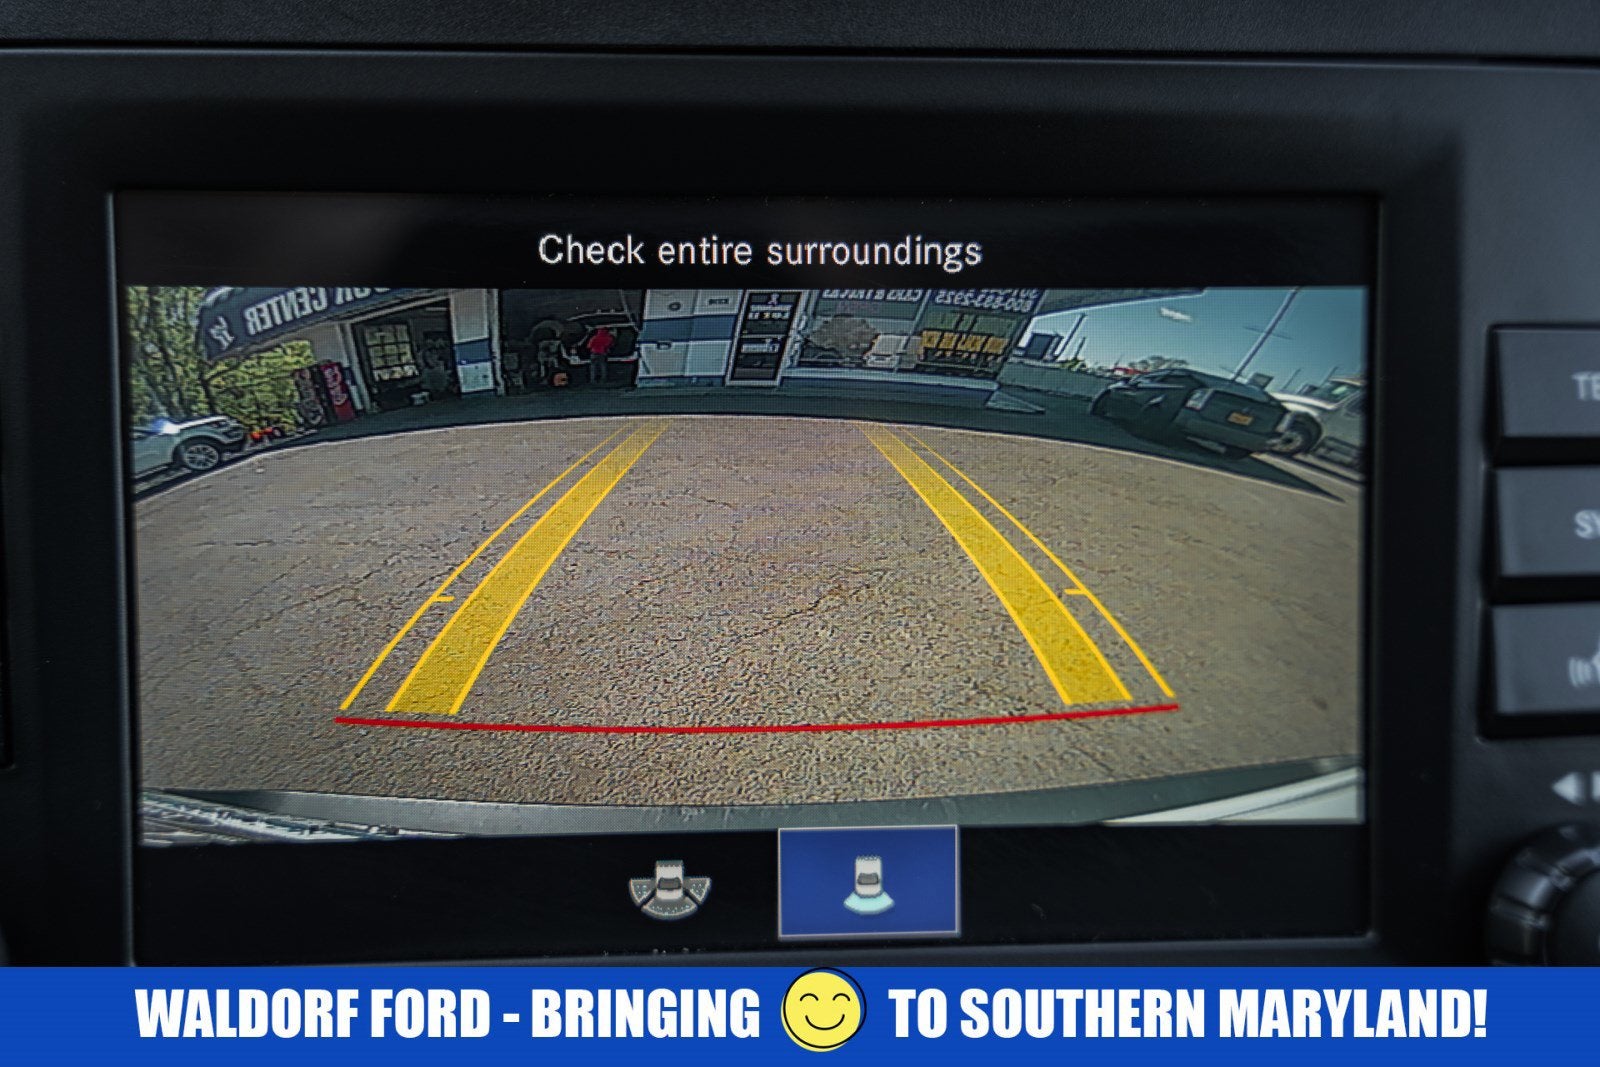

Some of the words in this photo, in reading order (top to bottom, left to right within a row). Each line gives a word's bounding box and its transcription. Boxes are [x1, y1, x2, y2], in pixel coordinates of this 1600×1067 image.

[537, 233, 646, 266] Check
[657, 233, 754, 266] entire
[766, 234, 983, 275] surroundings
